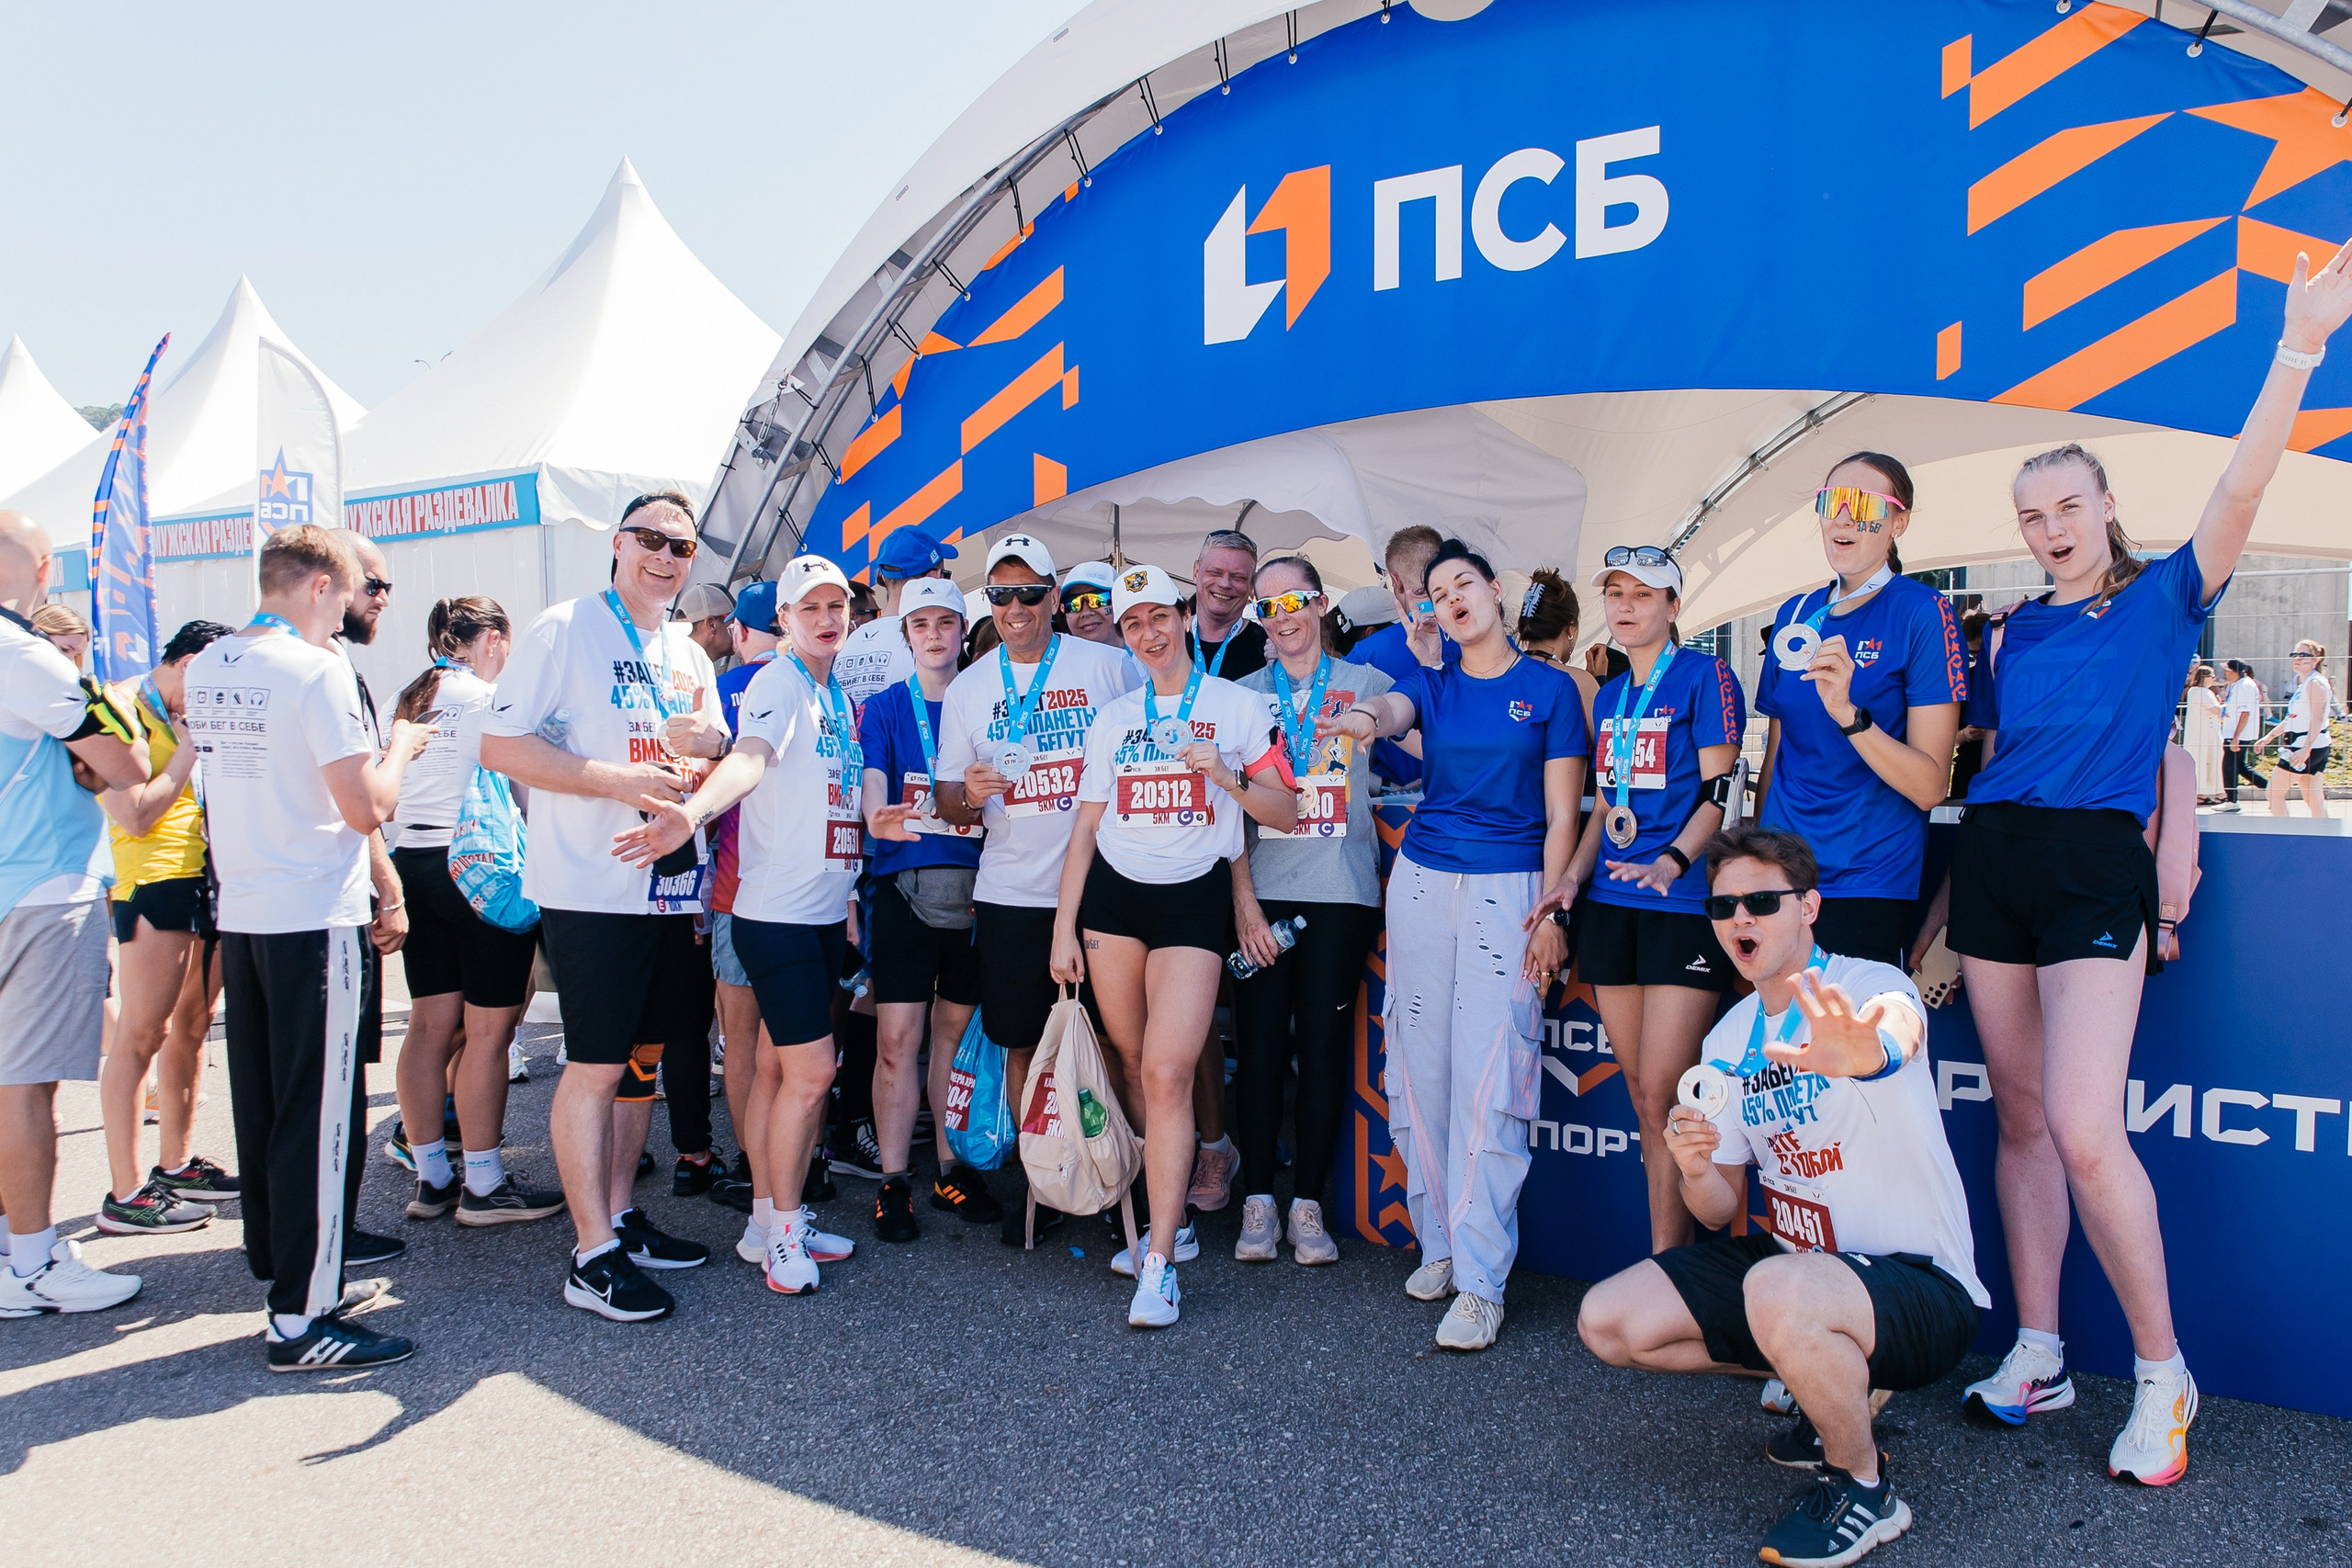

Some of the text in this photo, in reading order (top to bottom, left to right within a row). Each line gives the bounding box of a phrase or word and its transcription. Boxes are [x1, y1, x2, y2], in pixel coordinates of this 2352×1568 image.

[1374, 125, 1669, 291] ПСБ
[415, 480, 519, 533] РАЗДЕВАЛКА
[213, 517, 254, 555] РАЗДЕ
[1855, 651, 1879, 660] ПСБ
[611, 685, 650, 709] 45%
[1509, 708, 1531, 716] ПСБ
[210, 721, 227, 730] БЕГ
[231, 722, 235, 730] В
[239, 722, 266, 732] СЕБЕ
[1036, 729, 1085, 752] БЕГУТ
[1604, 738, 1657, 768] 254
[1012, 765, 1076, 799] 20532
[1131, 779, 1193, 809] 20312
[832, 827, 859, 854] 20531
[655, 870, 697, 897] 30366
[1685, 964, 1712, 973] DEMIX
[1938, 1059, 2352, 1156] РИСТ
[1771, 1197, 1826, 1247] 20451
